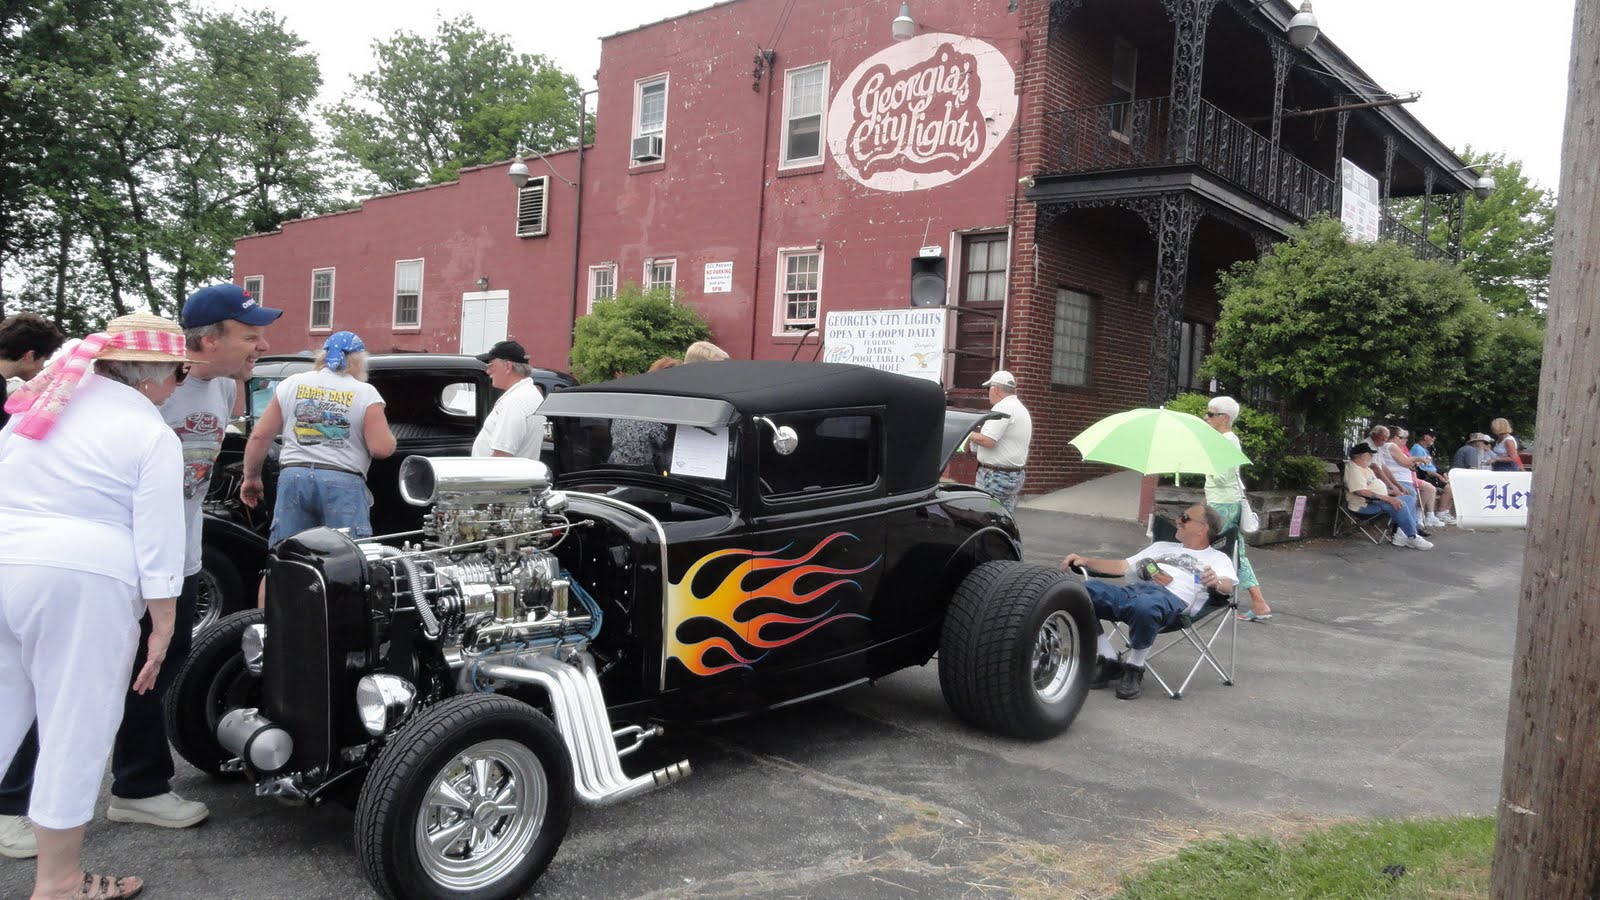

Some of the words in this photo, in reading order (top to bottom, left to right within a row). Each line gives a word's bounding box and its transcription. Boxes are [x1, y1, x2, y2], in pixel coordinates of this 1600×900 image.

[858, 52, 970, 118] Georgia's
[850, 113, 906, 166] City
[906, 100, 979, 162] Lights
[828, 314, 877, 327] GEORGIA'S
[880, 313, 901, 326] CITY
[904, 312, 941, 325] LIGHTS
[829, 330, 853, 339] OPEN
[856, 329, 867, 338] AT
[907, 328, 937, 338] DAILY
[852, 355, 873, 363] POOL
[876, 355, 905, 363] TABLES
[879, 363, 901, 372] HOLE
[296, 384, 328, 401] HAPPY
[328, 390, 355, 407] DAYS
